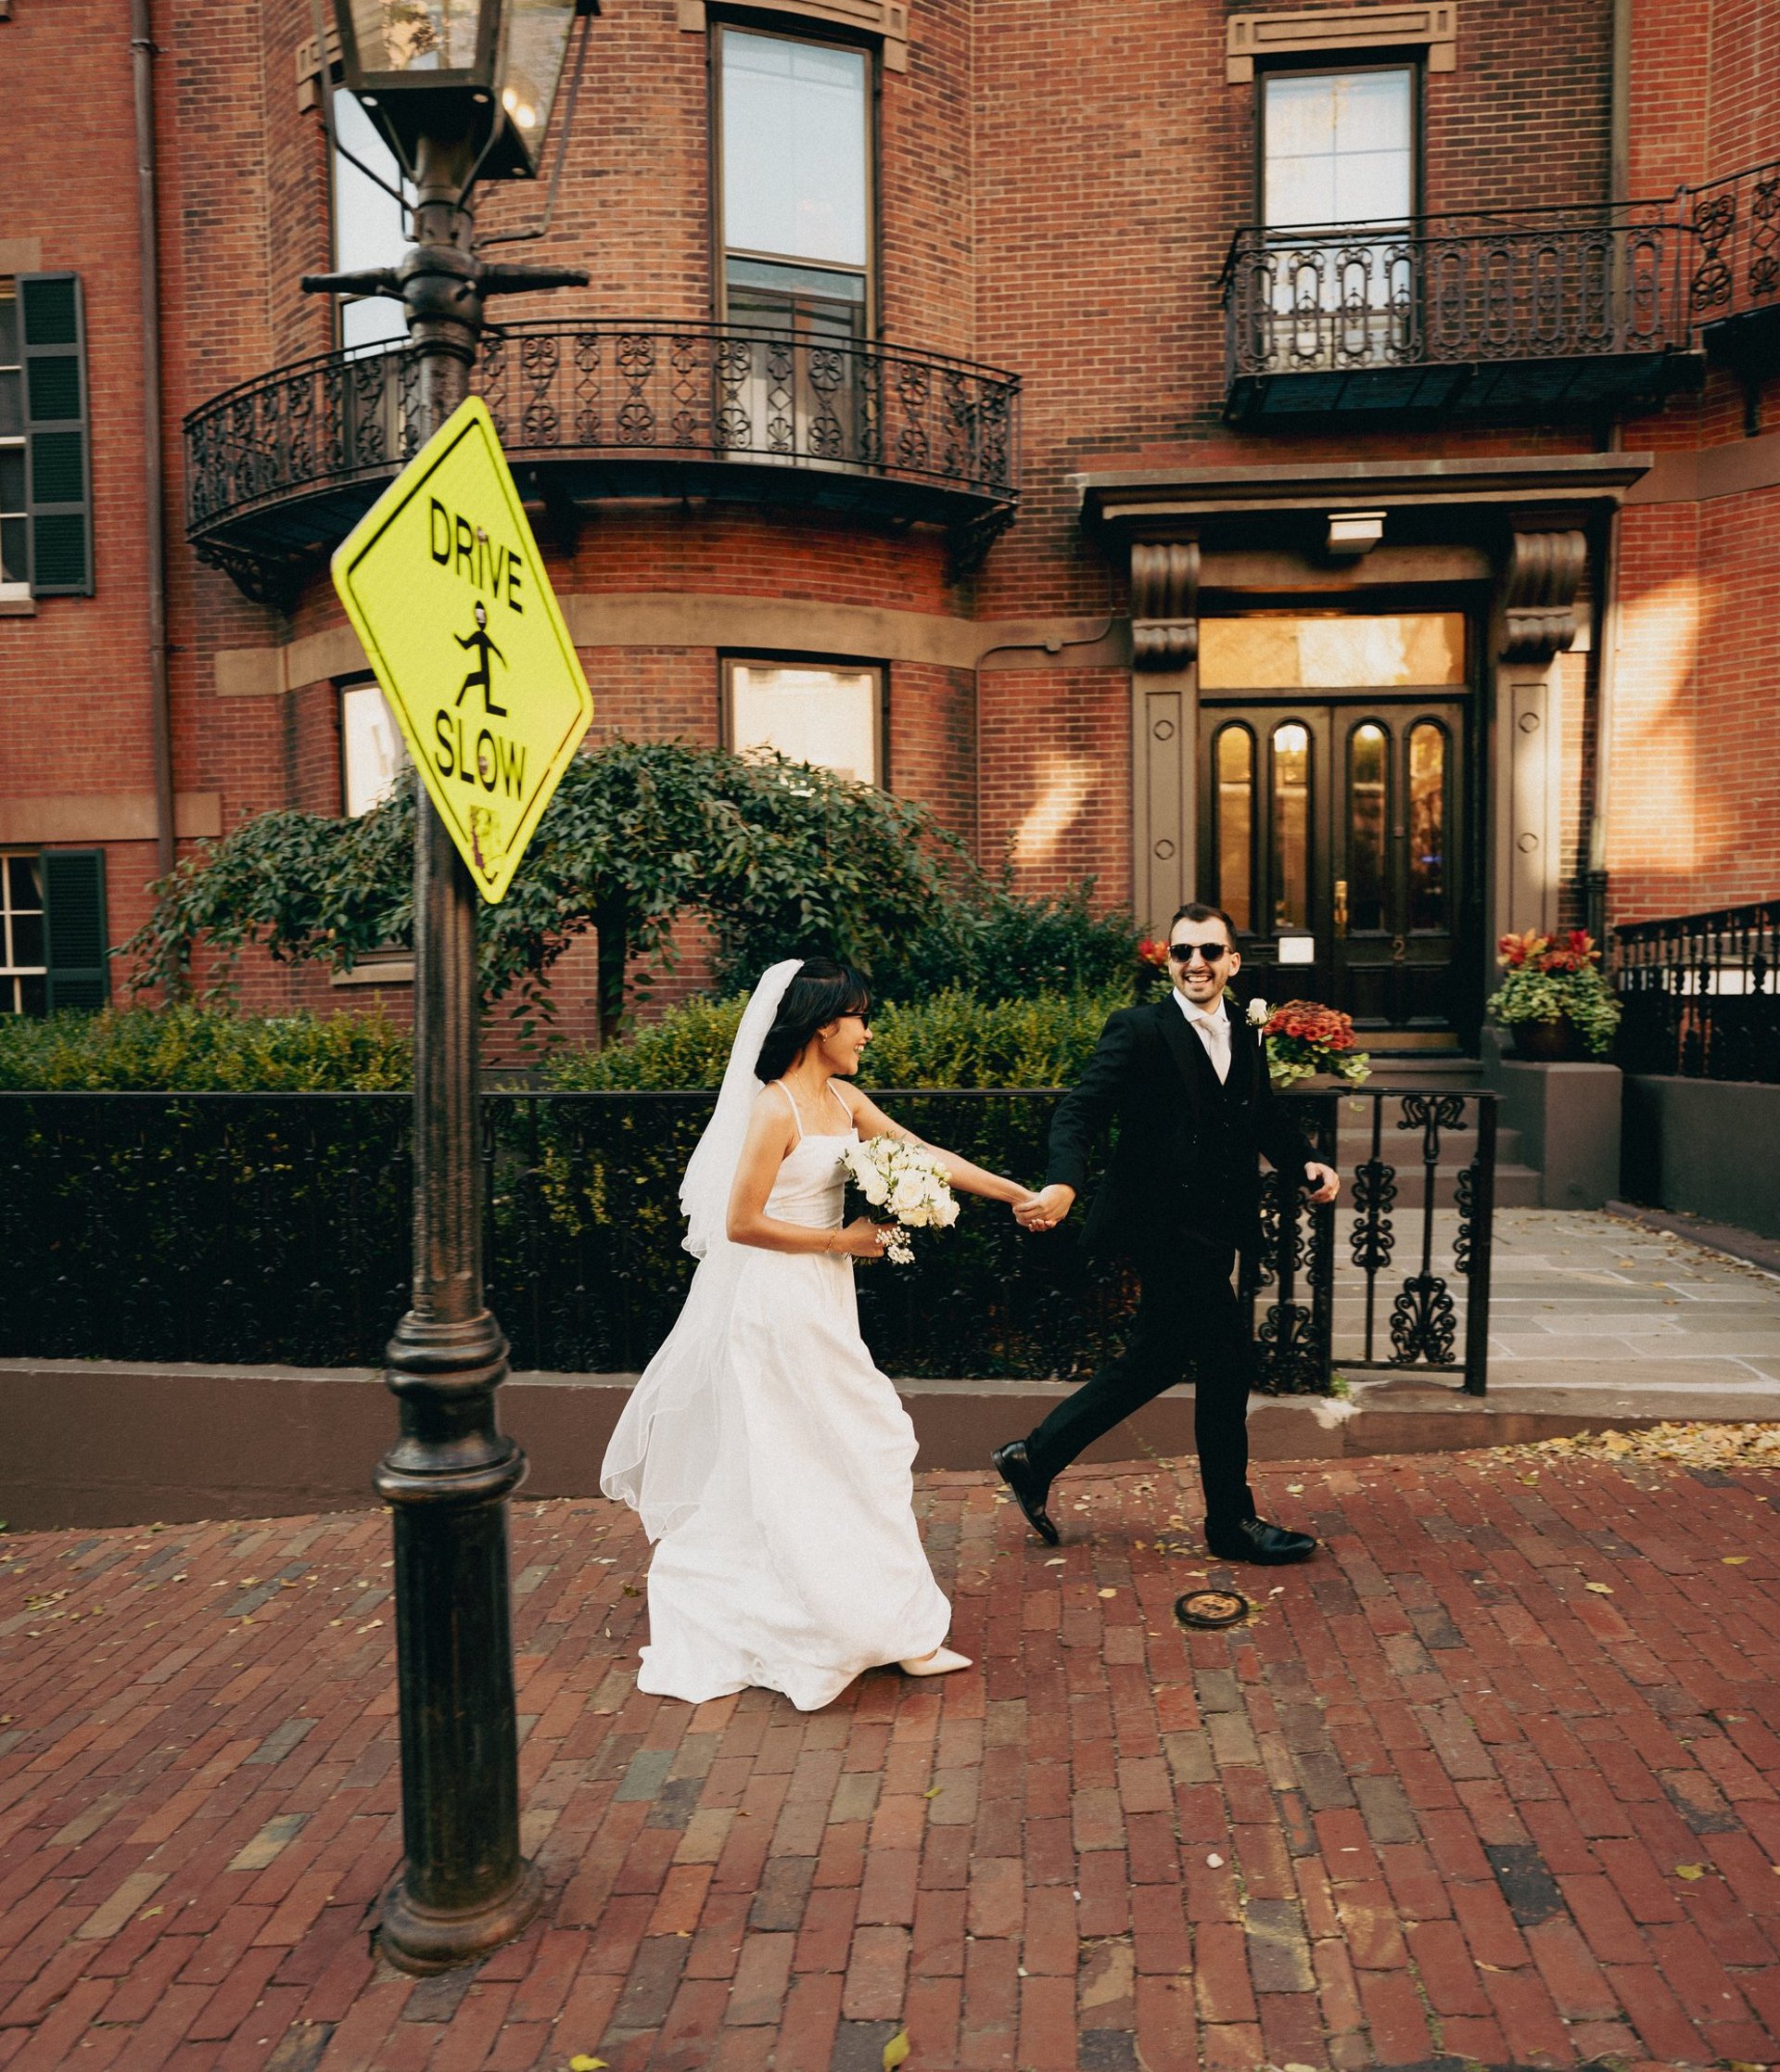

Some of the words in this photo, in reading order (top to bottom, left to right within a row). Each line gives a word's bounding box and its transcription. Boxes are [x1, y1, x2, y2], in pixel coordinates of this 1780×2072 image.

[430, 497, 523, 614] DRIVE
[435, 709, 526, 801] SLOW
[1392, 939, 1405, 960] 2
